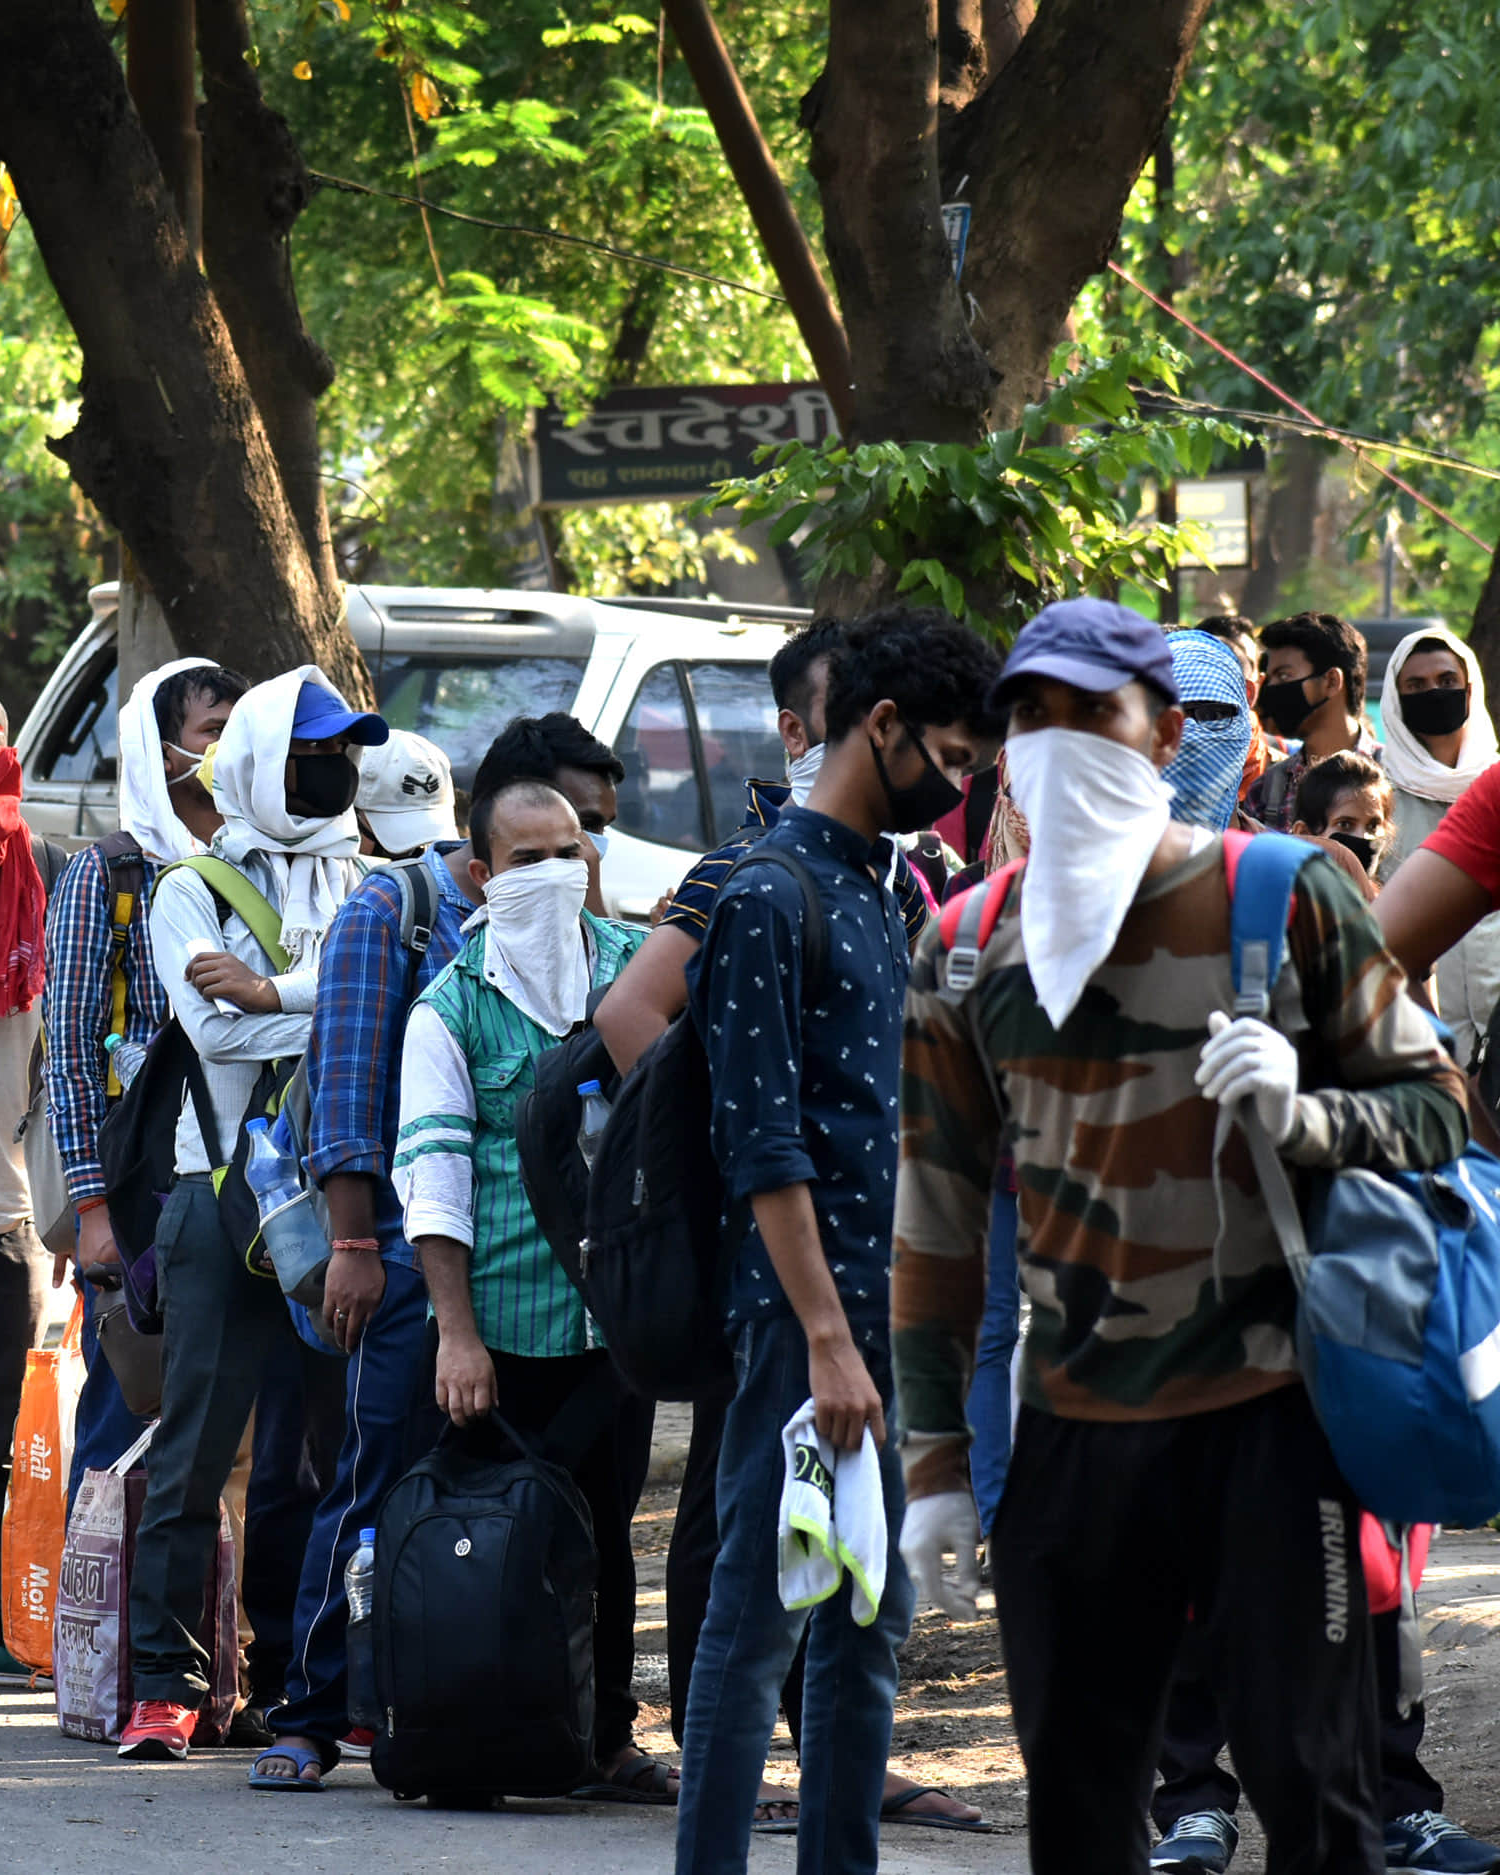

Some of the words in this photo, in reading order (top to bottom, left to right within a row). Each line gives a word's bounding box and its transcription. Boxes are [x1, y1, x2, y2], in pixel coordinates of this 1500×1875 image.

[550, 388, 842, 455] स्वदेशी
[30, 1433, 52, 1482] मोती
[29, 1562, 50, 1621] Moti
